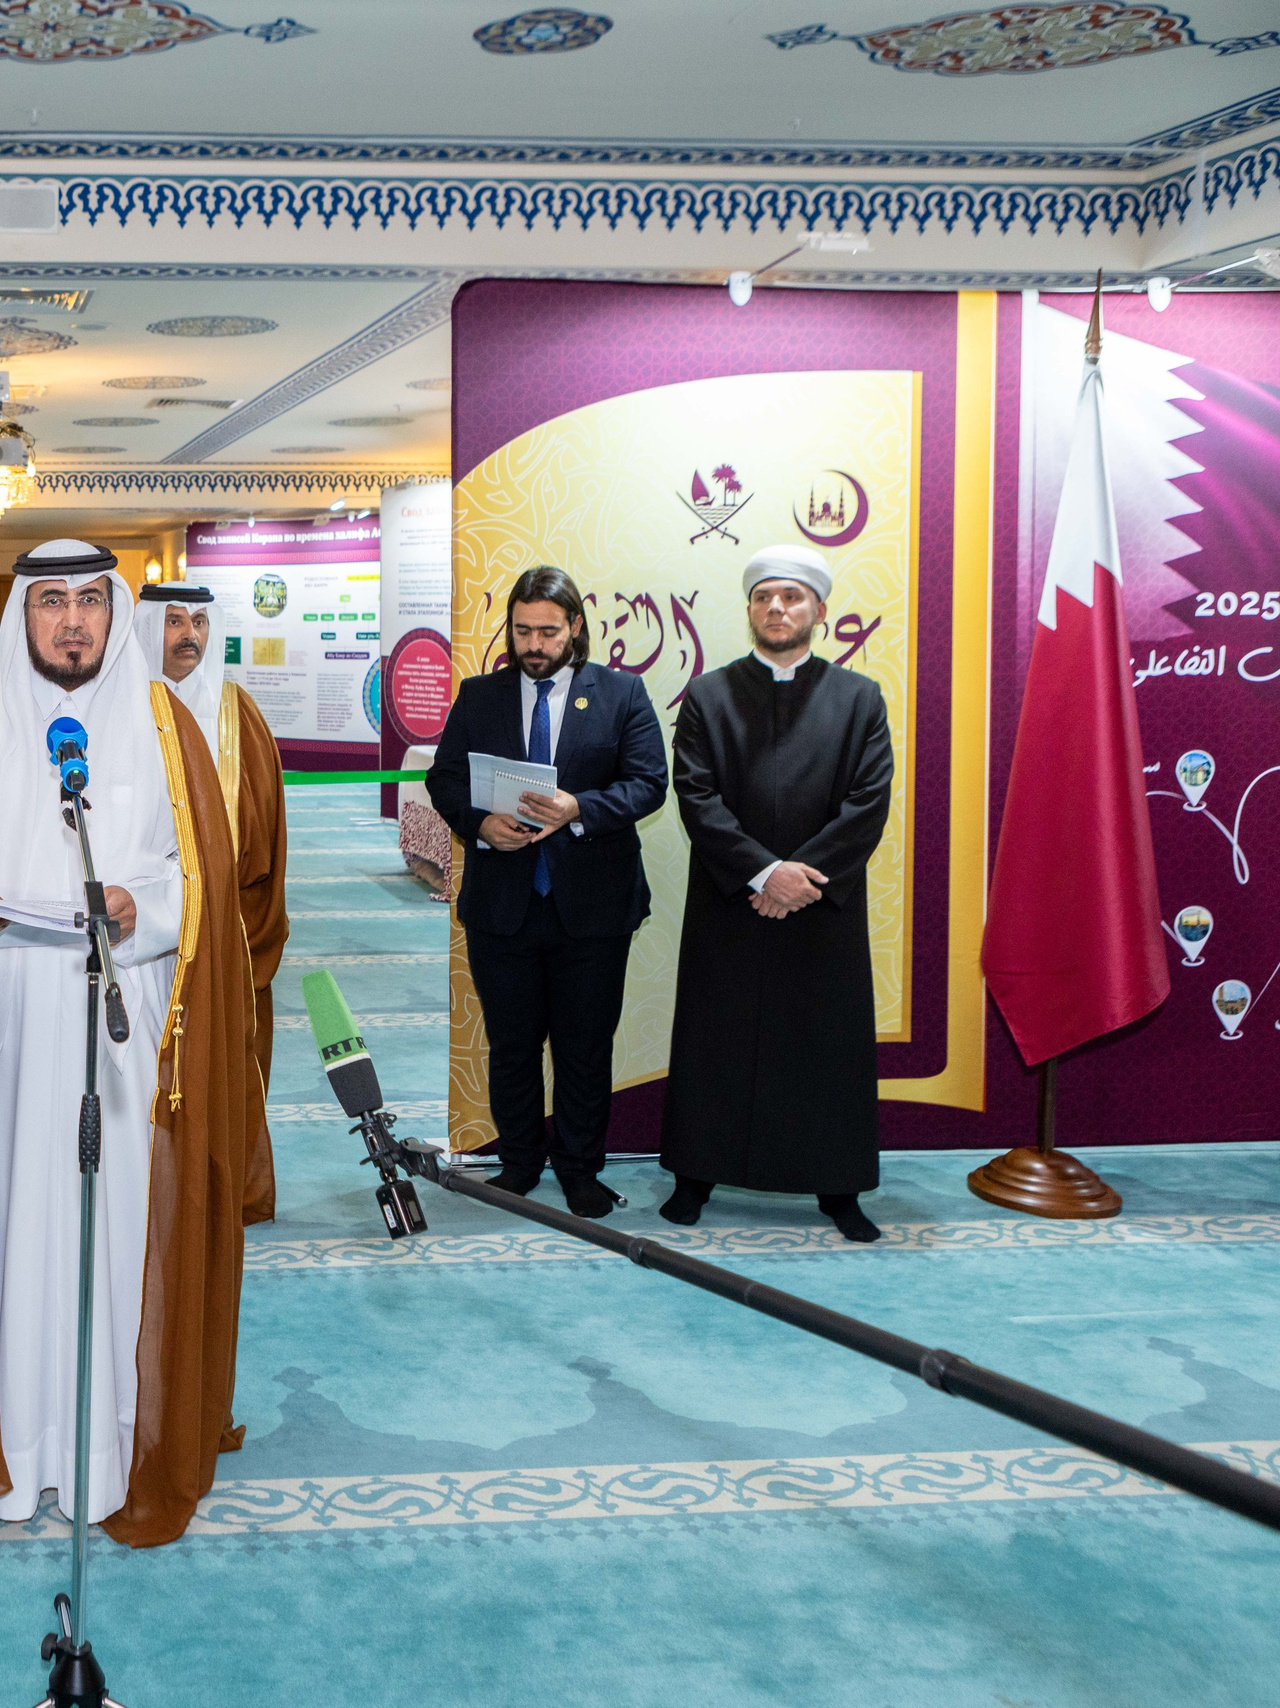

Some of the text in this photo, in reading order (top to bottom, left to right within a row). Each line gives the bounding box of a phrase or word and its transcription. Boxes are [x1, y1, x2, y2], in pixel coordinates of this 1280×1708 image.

[197, 534, 217, 545] Свод
[252, 532, 283, 546] Корана
[284, 534, 296, 543] во
[296, 531, 334, 544] времена
[335, 528, 370, 542] халифа
[1195, 591, 1280, 620] 2025
[322, 1037, 354, 1060] RT
